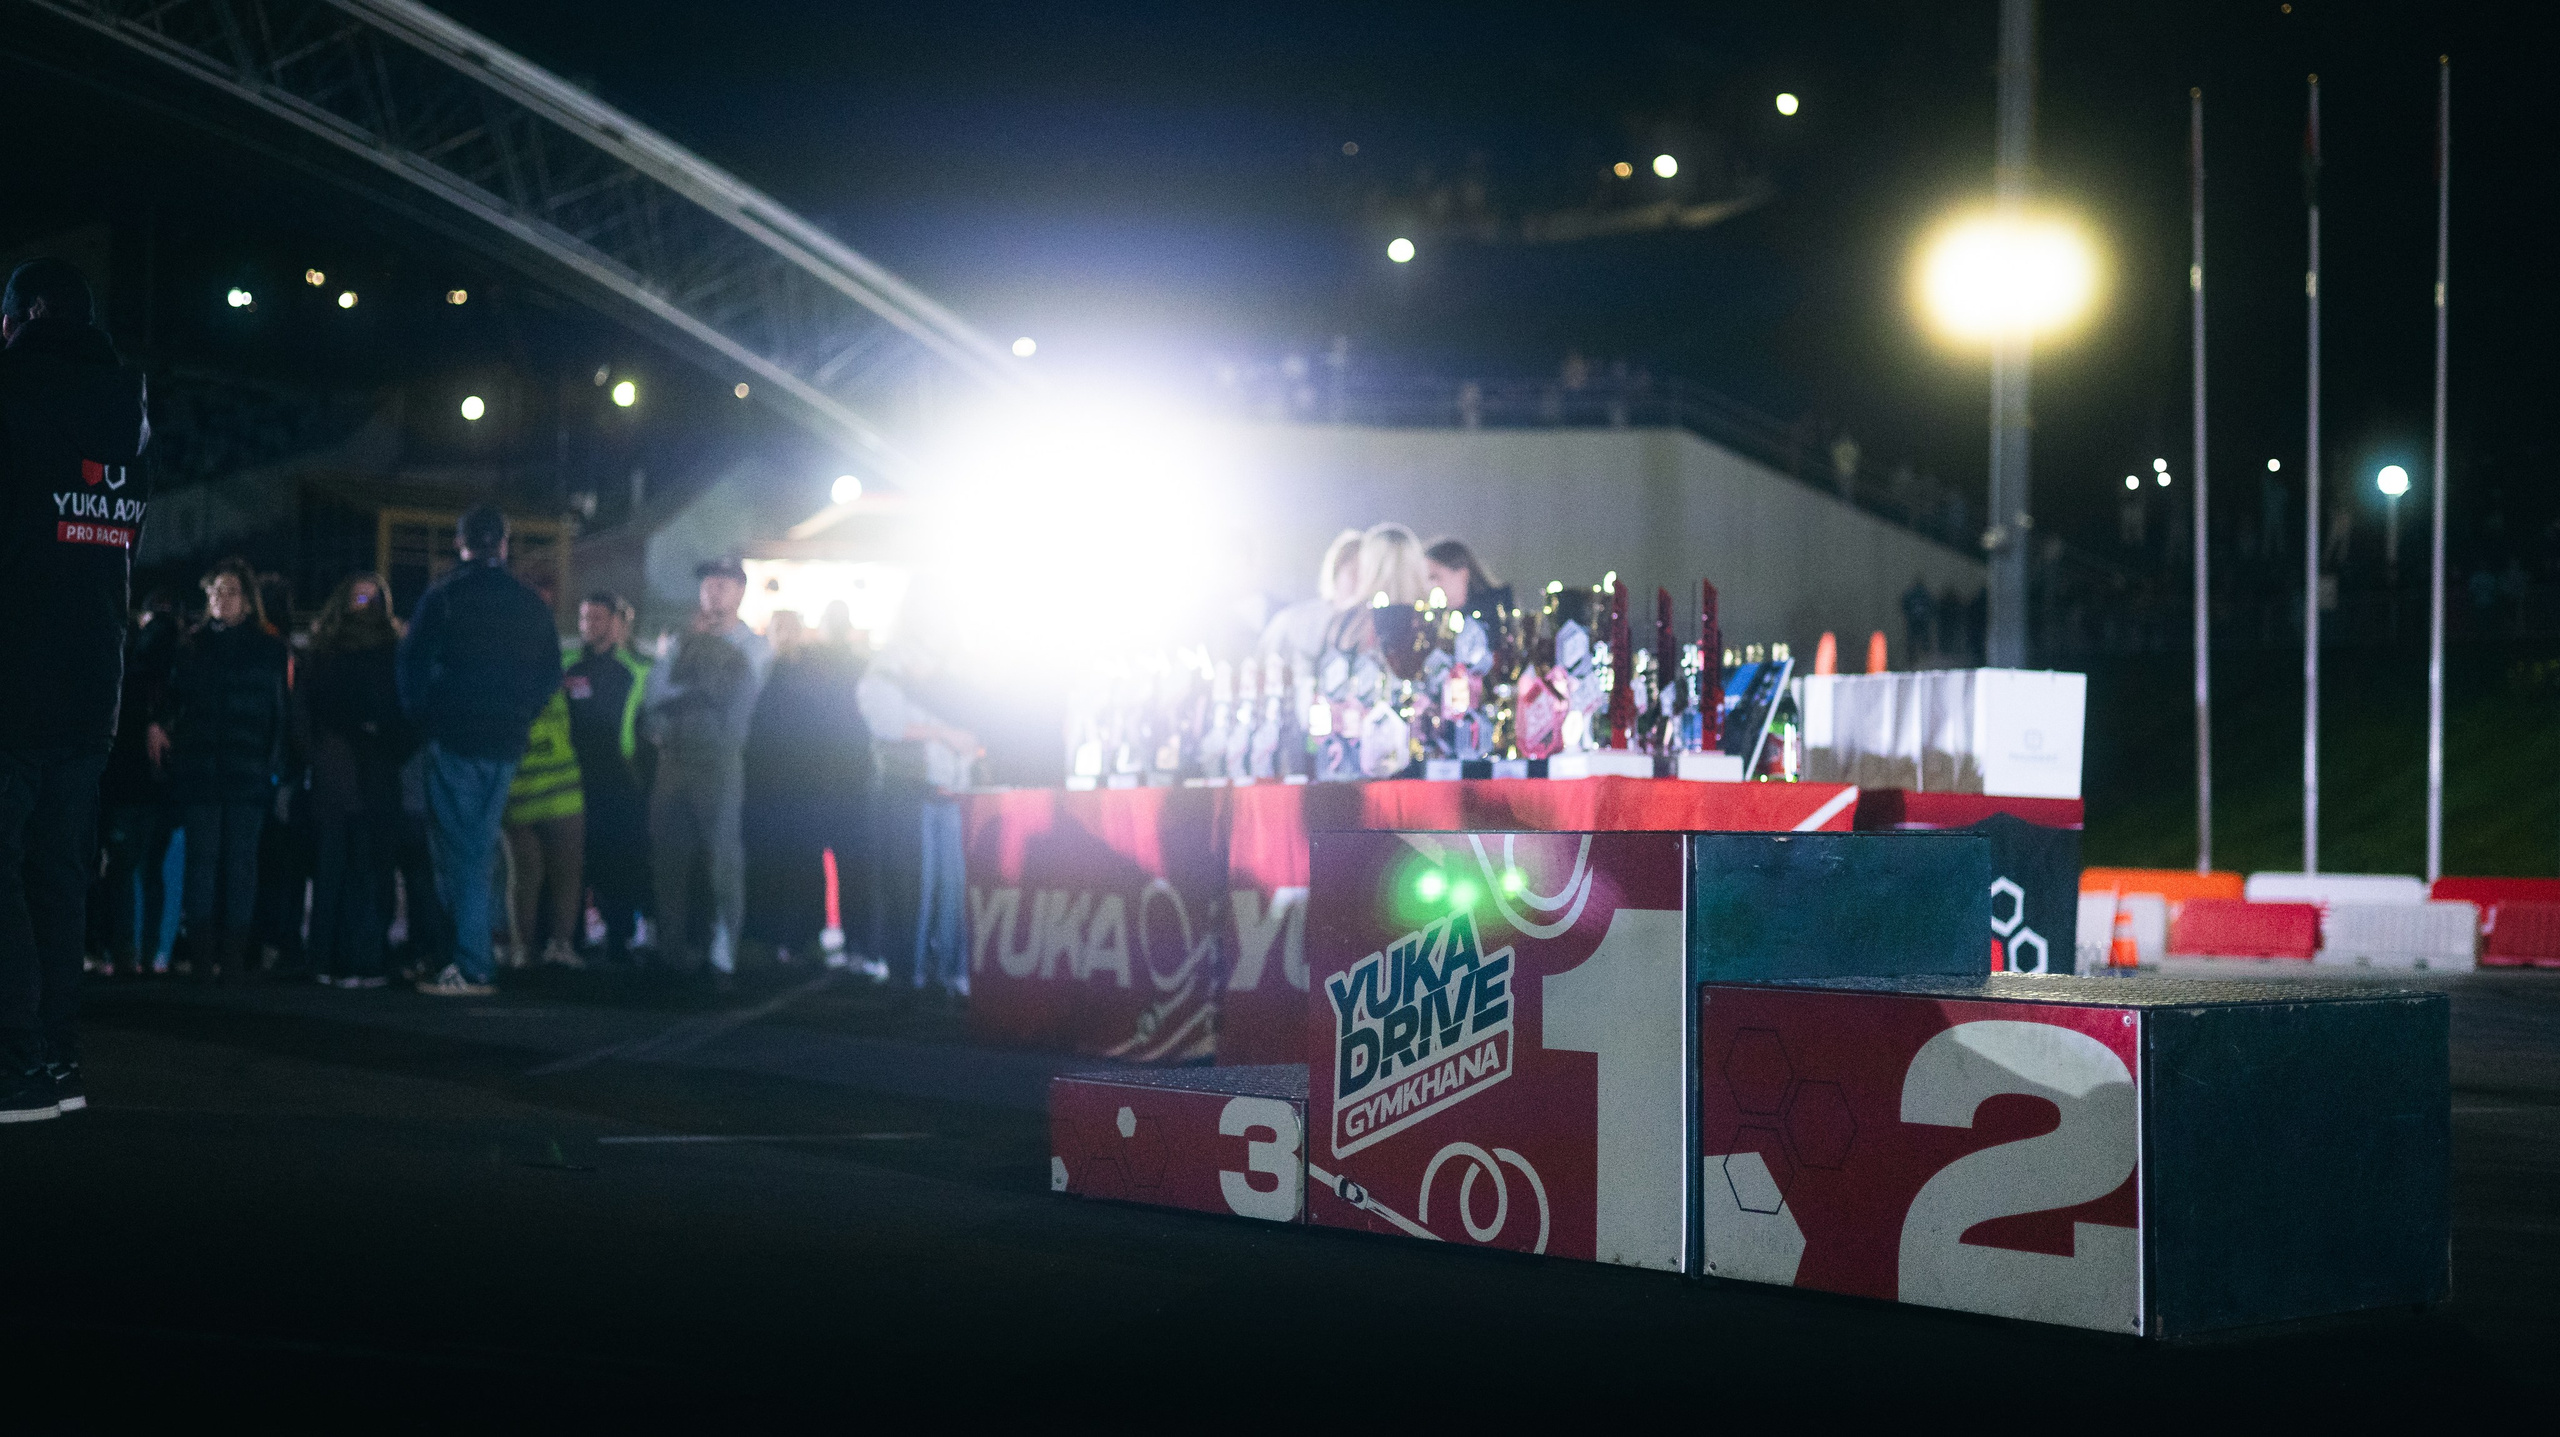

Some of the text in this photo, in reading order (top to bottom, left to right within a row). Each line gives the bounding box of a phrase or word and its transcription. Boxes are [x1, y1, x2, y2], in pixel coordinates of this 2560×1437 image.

[53, 492, 109, 519] YUKA
[66, 525, 93, 541] PRO
[969, 886, 1131, 989] YUKA
[1330, 907, 1482, 1037] YUKA
[1339, 955, 1510, 1100] DRIVE
[1345, 1041, 1501, 1137] GYMKHANA
[1542, 908, 1684, 1271] 1
[1218, 1096, 1303, 1223] 3
[1898, 1020, 2140, 1335] 2
